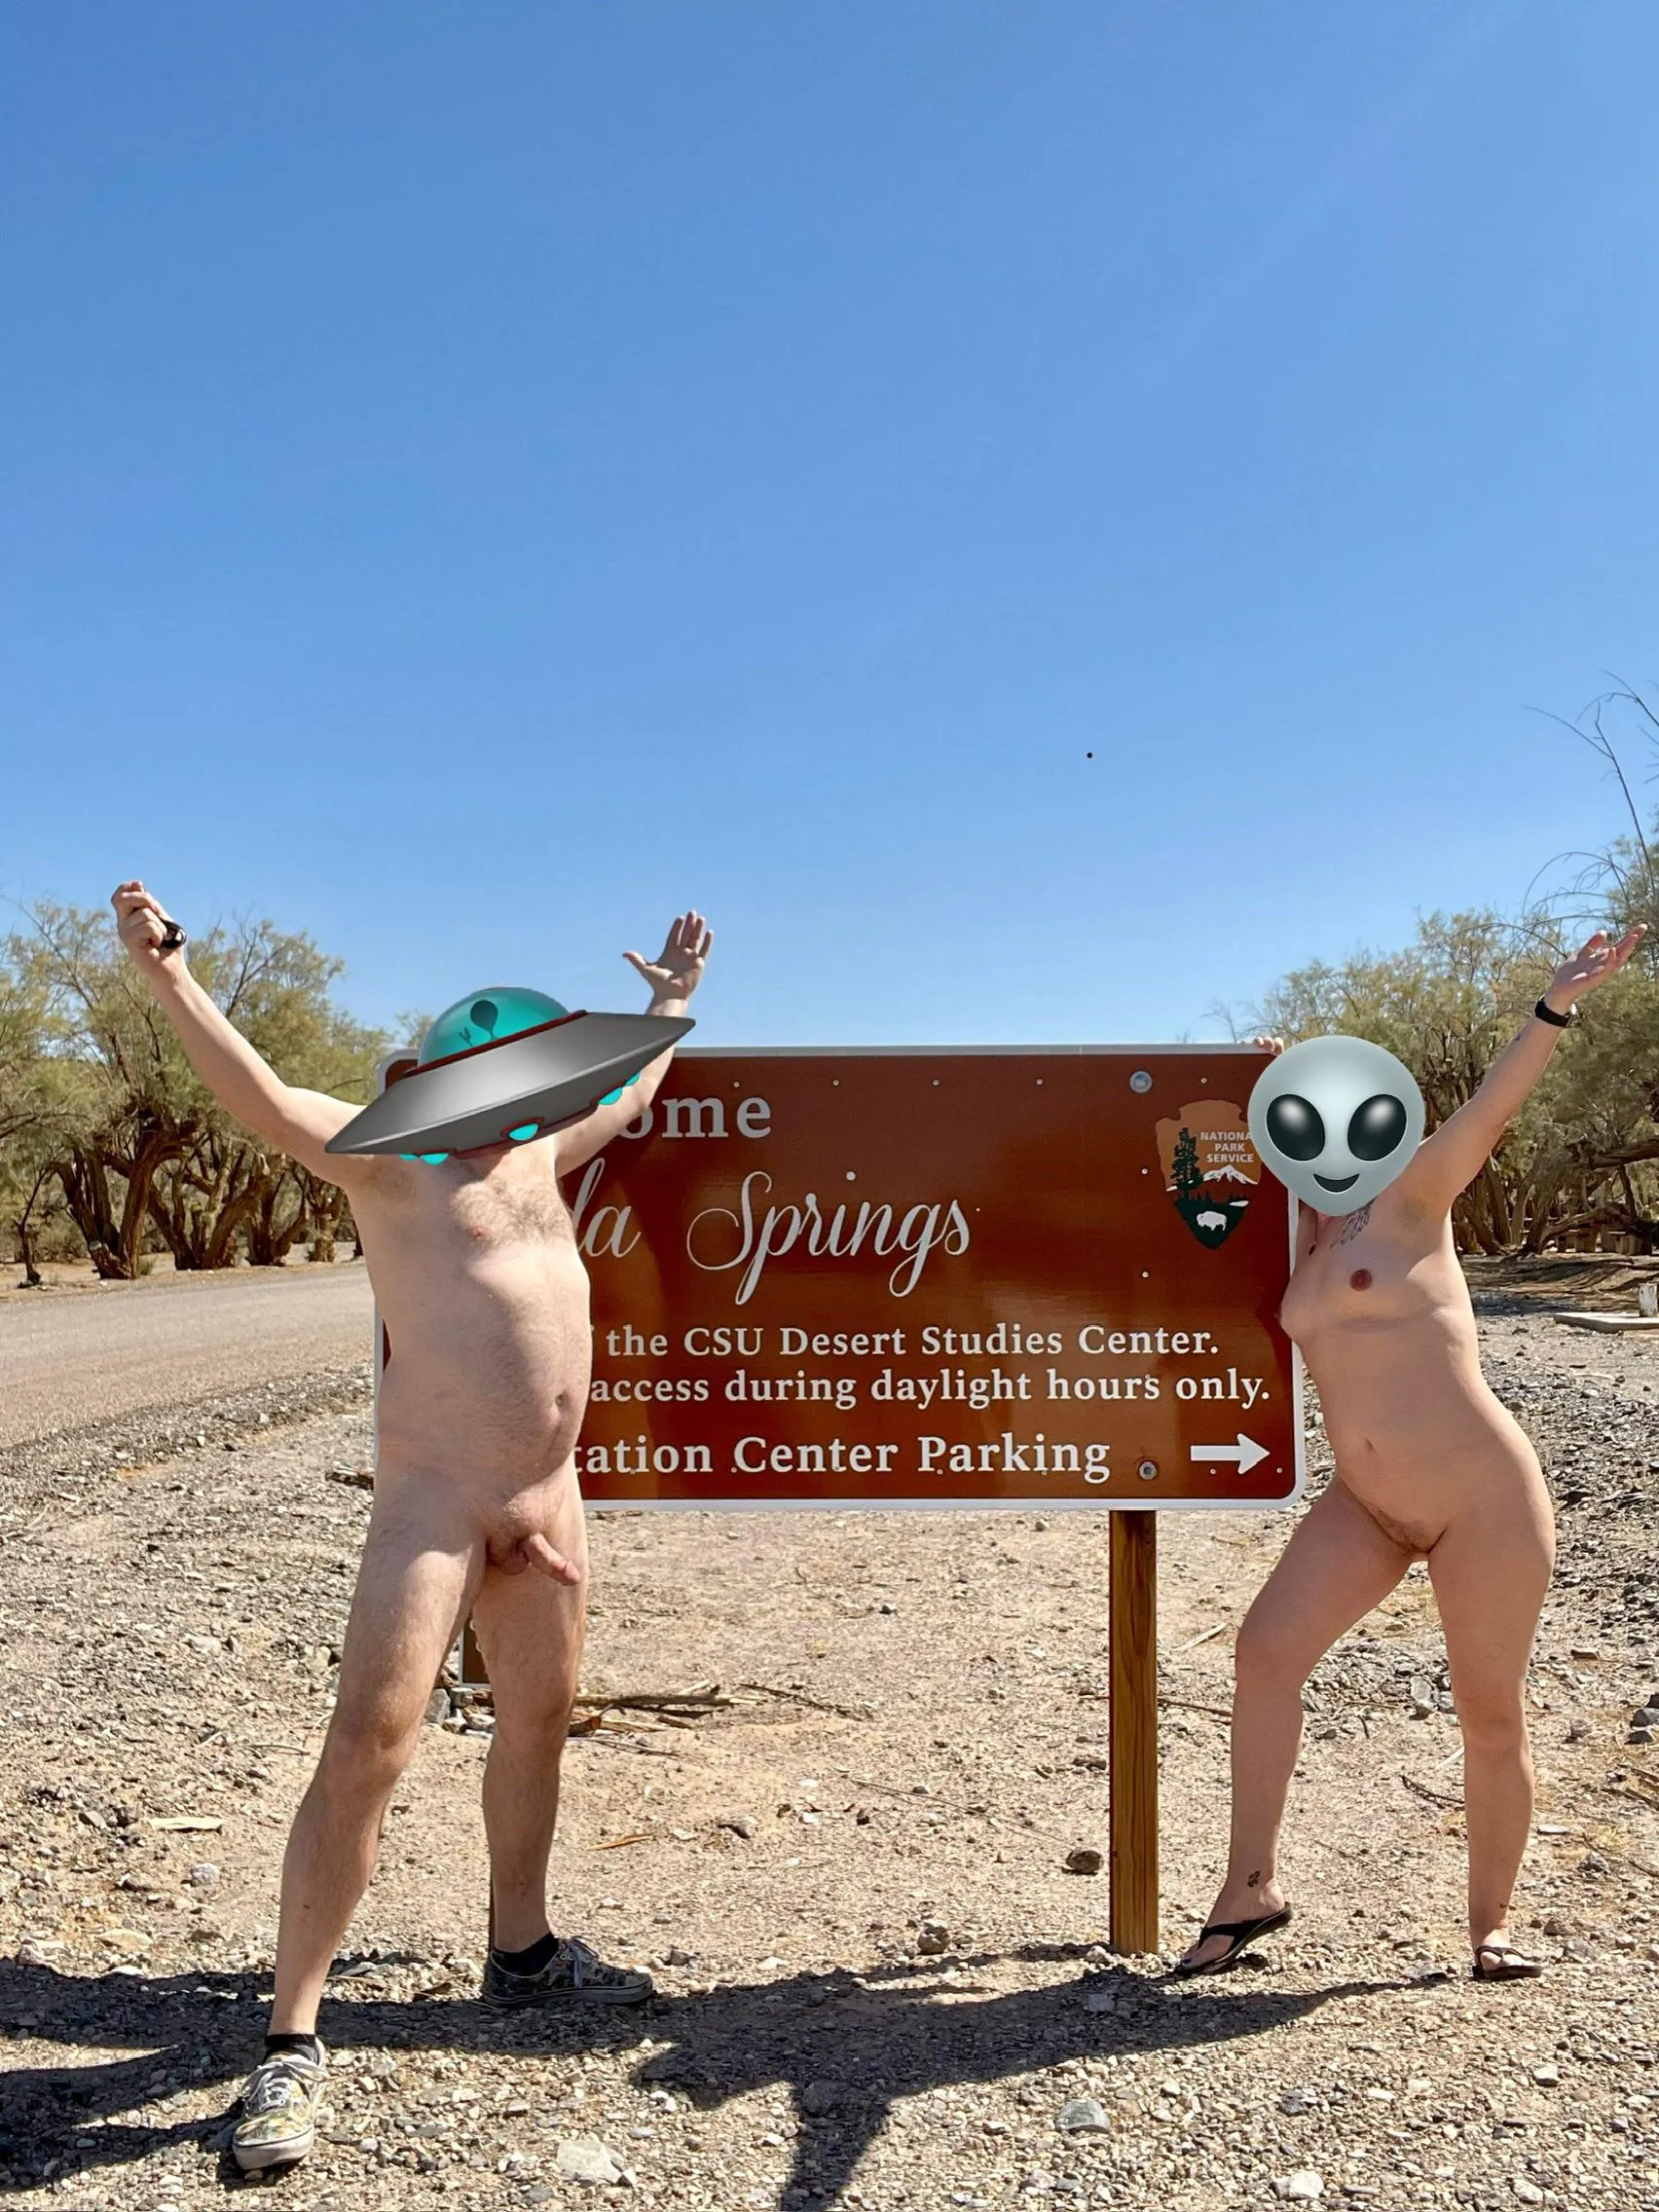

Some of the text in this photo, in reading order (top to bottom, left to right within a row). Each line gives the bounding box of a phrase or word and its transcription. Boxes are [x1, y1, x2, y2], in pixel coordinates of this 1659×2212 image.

[1206, 1153, 1254, 1162] SERVICE
[1214, 1142, 1245, 1152] PARK
[686, 1171, 970, 1306] Springs
[606, 1323, 1219, 1356] the CSU Desert Studies Center.
[591, 1368, 1271, 1410] access during daylight hours only.
[733, 1436, 899, 1473] Center
[917, 1432, 1111, 1485] Parking
